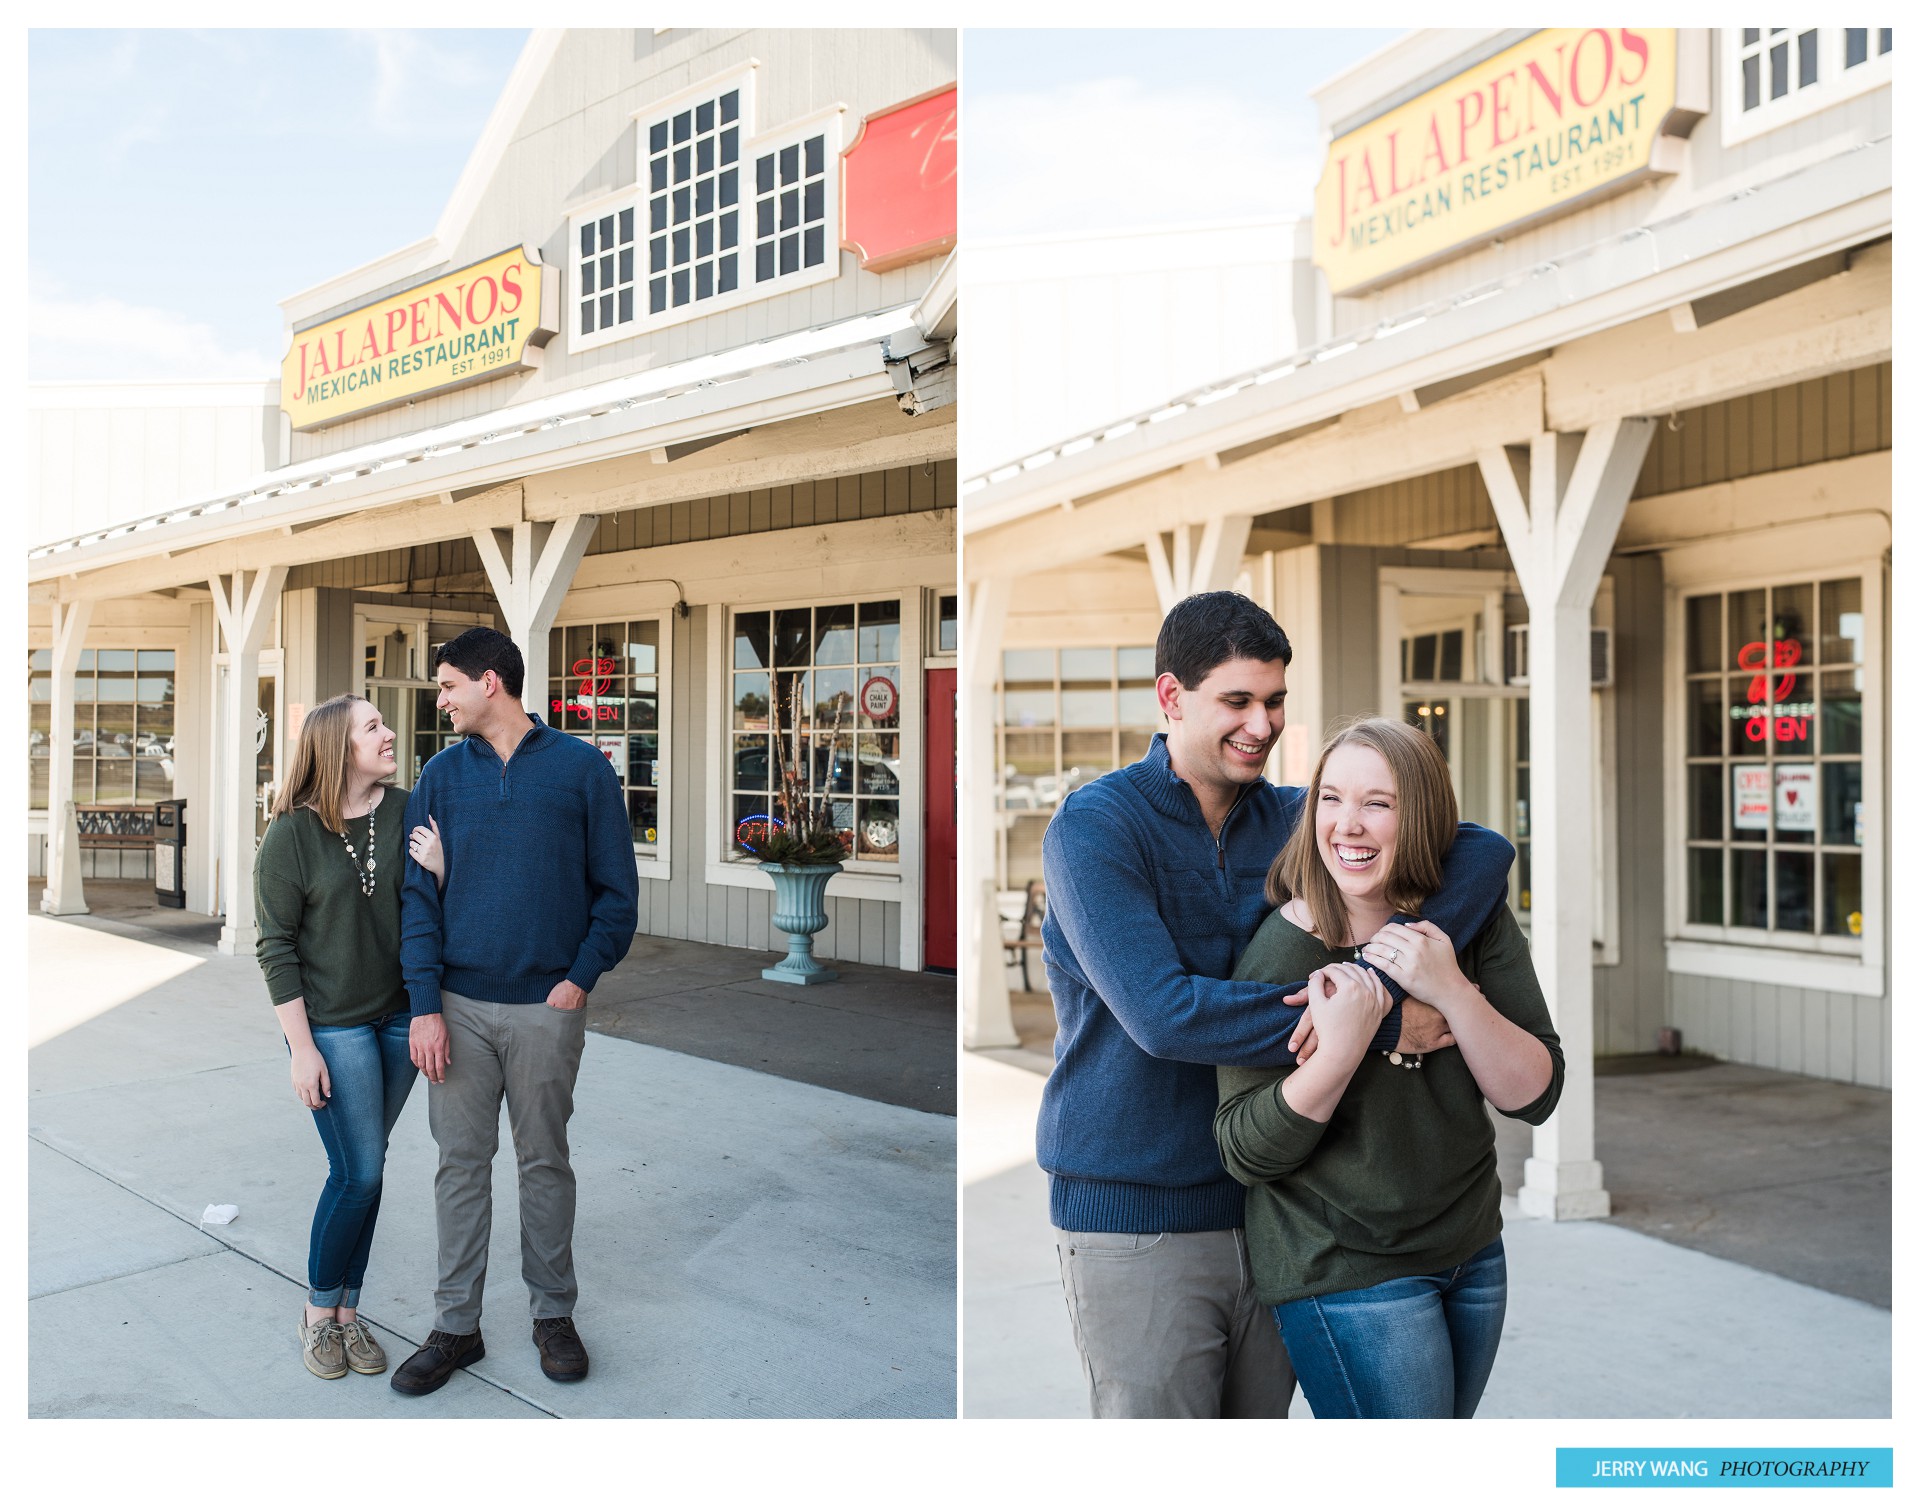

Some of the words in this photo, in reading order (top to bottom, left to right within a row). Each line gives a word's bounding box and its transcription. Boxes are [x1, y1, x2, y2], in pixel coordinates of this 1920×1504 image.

[1330, 28, 1649, 247] JALAPENOS
[1350, 183, 1451, 251] MEXICAN
[1461, 94, 1646, 205] RESTAURANT
[1593, 142, 1635, 174] 1991
[293, 262, 523, 401] JALAPENOS
[307, 363, 382, 406] MEXICAN
[388, 317, 520, 380] RESTAURANT
[481, 346, 512, 367] 1991
[869, 694, 888, 702] CHALK
